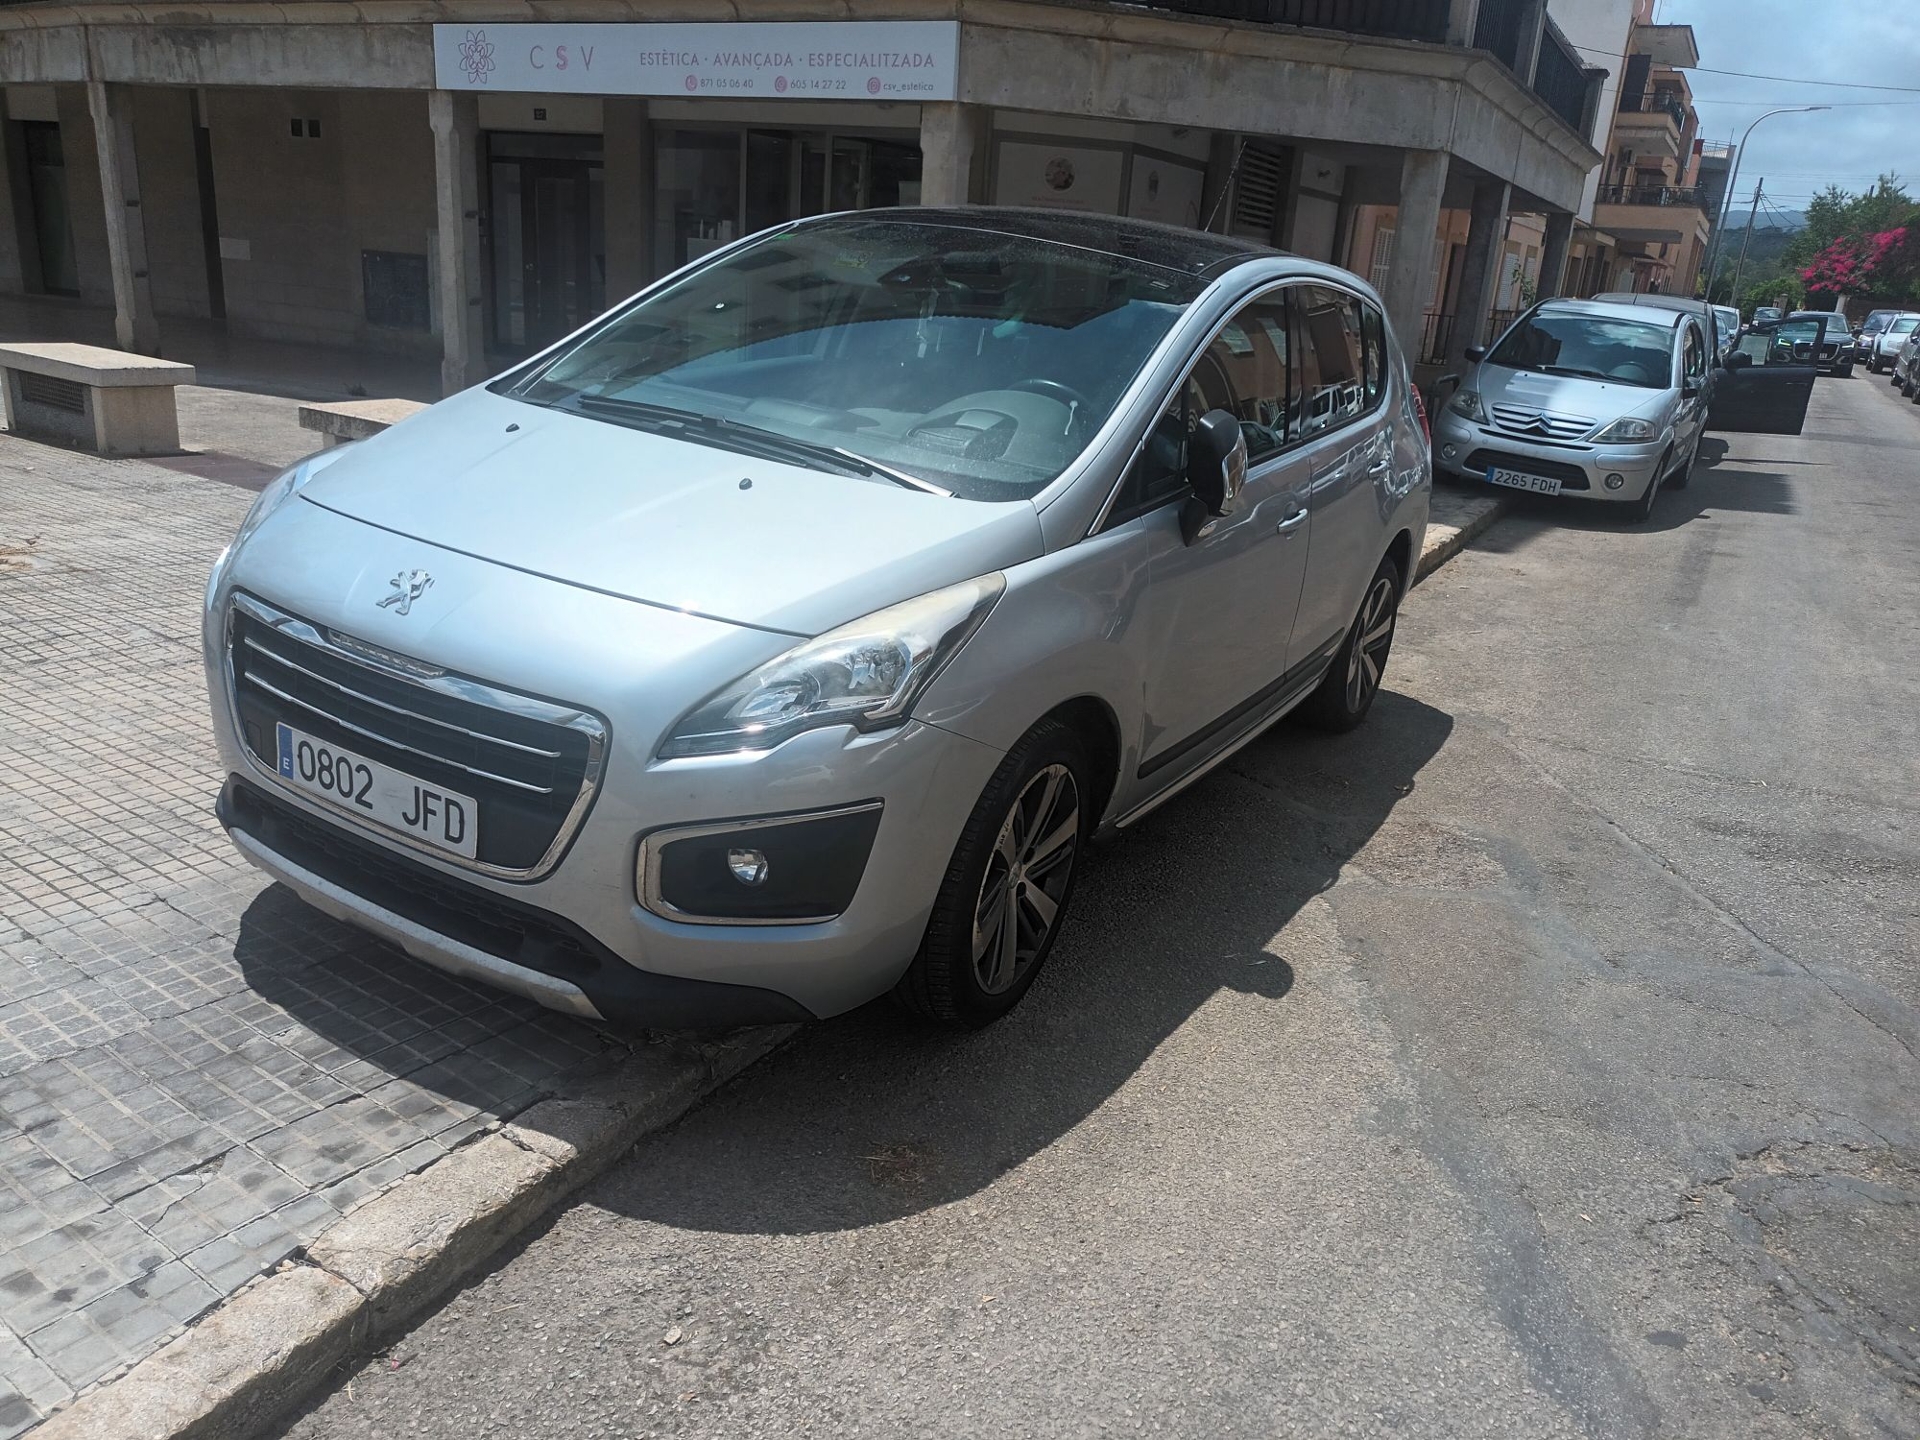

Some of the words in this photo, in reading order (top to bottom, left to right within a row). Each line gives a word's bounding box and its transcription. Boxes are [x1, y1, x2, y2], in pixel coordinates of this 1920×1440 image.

[640, 49, 699, 66] ESTÈTICA
[713, 53, 793, 70] AVANÇADA
[808, 53, 934, 68] ESPECIALITZADA
[700, 78, 713, 88] 871
[716, 79, 727, 88] 05
[743, 79, 754, 89] 40
[790, 79, 807, 89] 605
[810, 80, 819, 89] 14
[822, 80, 832, 90] 27
[835, 80, 846, 90] 22
[1495, 471, 1527, 488] 2265
[1531, 478, 1558, 493] FDH
[282, 757, 290, 770] E
[297, 740, 374, 810] 0802
[402, 786, 465, 844] JFD
